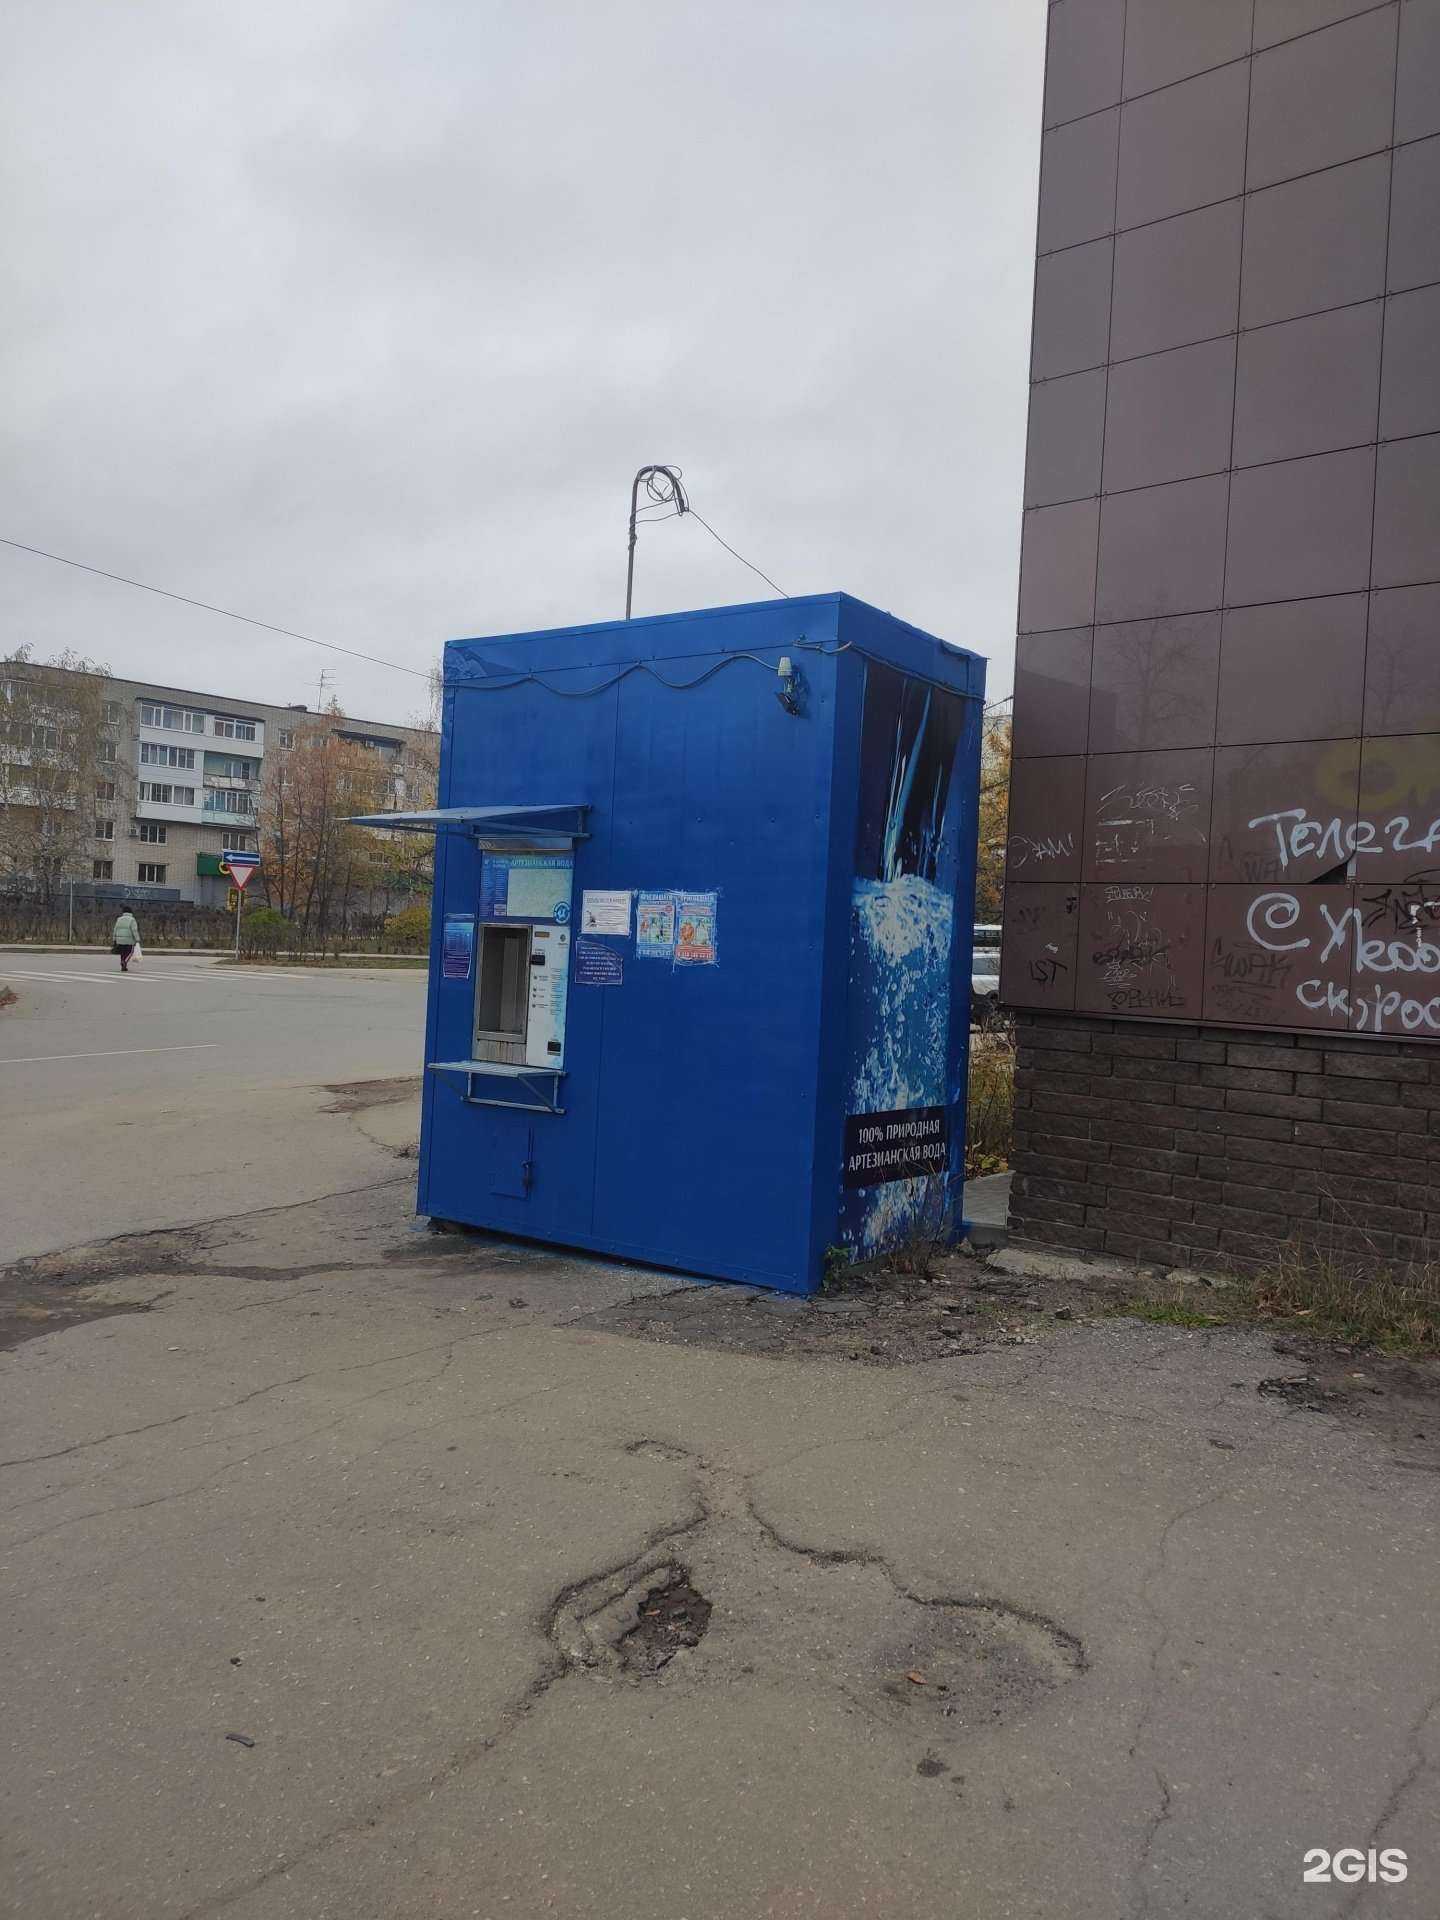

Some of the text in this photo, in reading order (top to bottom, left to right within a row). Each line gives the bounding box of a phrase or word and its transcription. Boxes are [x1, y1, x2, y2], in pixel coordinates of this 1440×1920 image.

[858, 1119, 940, 1144] 100% ПРИРОДНАЯ
[848, 1142, 946, 1172] АРТЕЗИАНСКАЯ ВОДА
